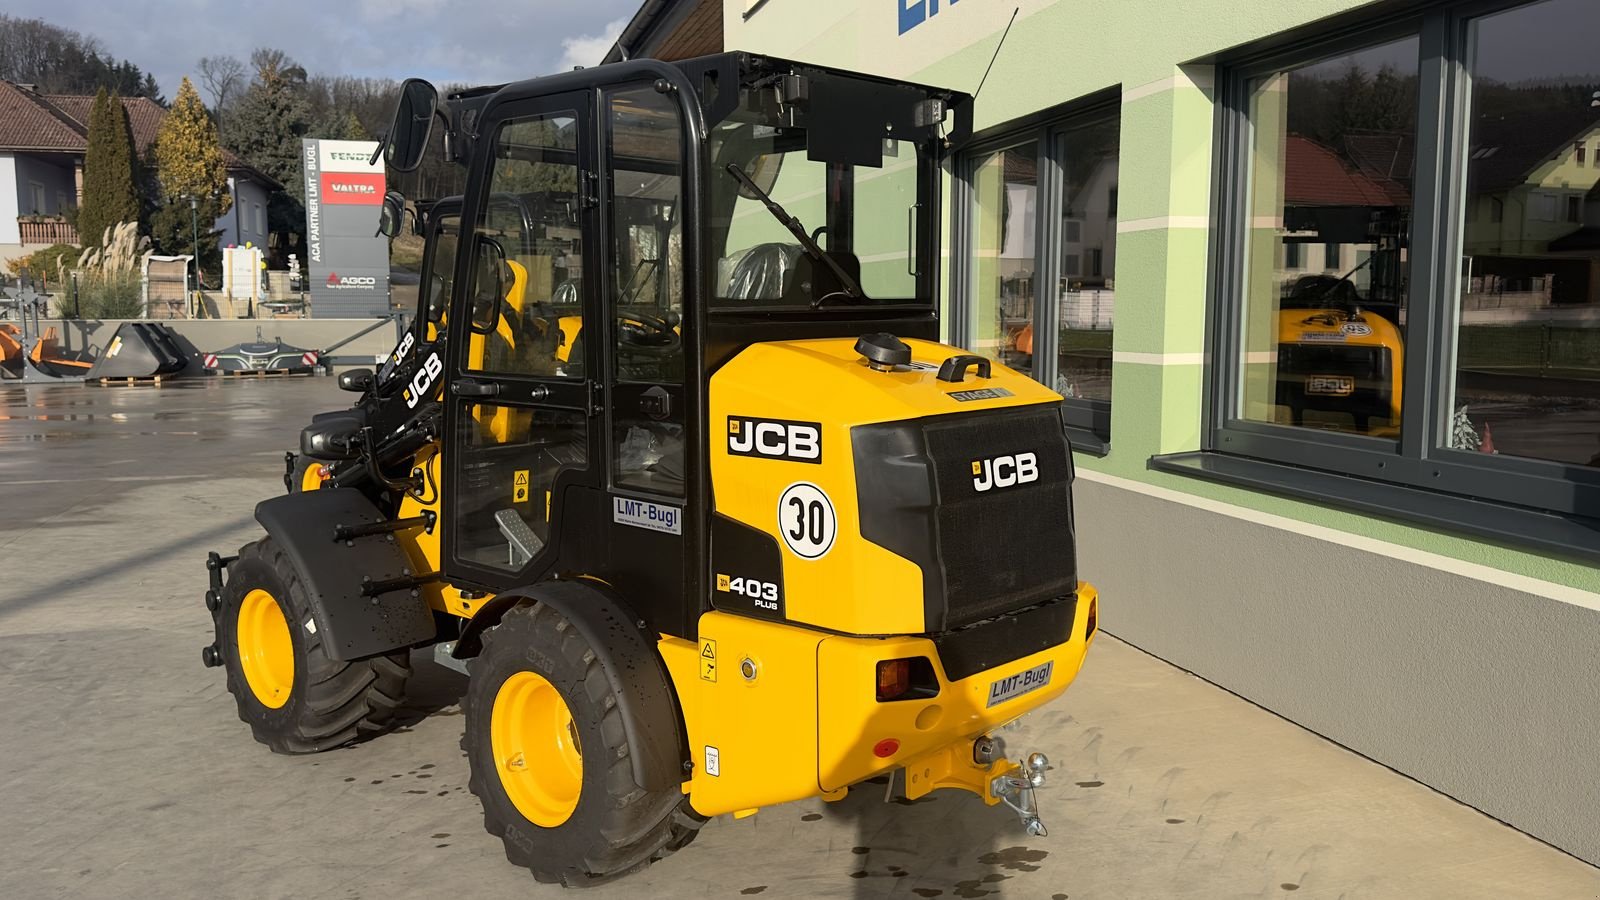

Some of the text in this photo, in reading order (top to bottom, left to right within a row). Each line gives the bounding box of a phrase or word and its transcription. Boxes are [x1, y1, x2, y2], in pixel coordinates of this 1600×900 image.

[306, 144, 317, 170] BUGL
[329, 152, 373, 161] FENDT
[308, 177, 318, 197] LMT
[331, 183, 376, 194] VALTRA
[309, 199, 320, 240] PARTNER
[312, 243, 321, 262] ACA
[340, 277, 376, 285] AGCO
[394, 332, 415, 366] JCB
[405, 352, 443, 409] JCB
[951, 389, 998, 401] STAGE
[729, 421, 820, 459] JCB
[973, 452, 1039, 492] JCB
[617, 499, 677, 527] LMT-Bugl
[788, 496, 825, 546] 30
[730, 577, 778, 601] 403
[754, 600, 778, 610] PLUS
[992, 663, 1051, 698] LMT-Bugl
